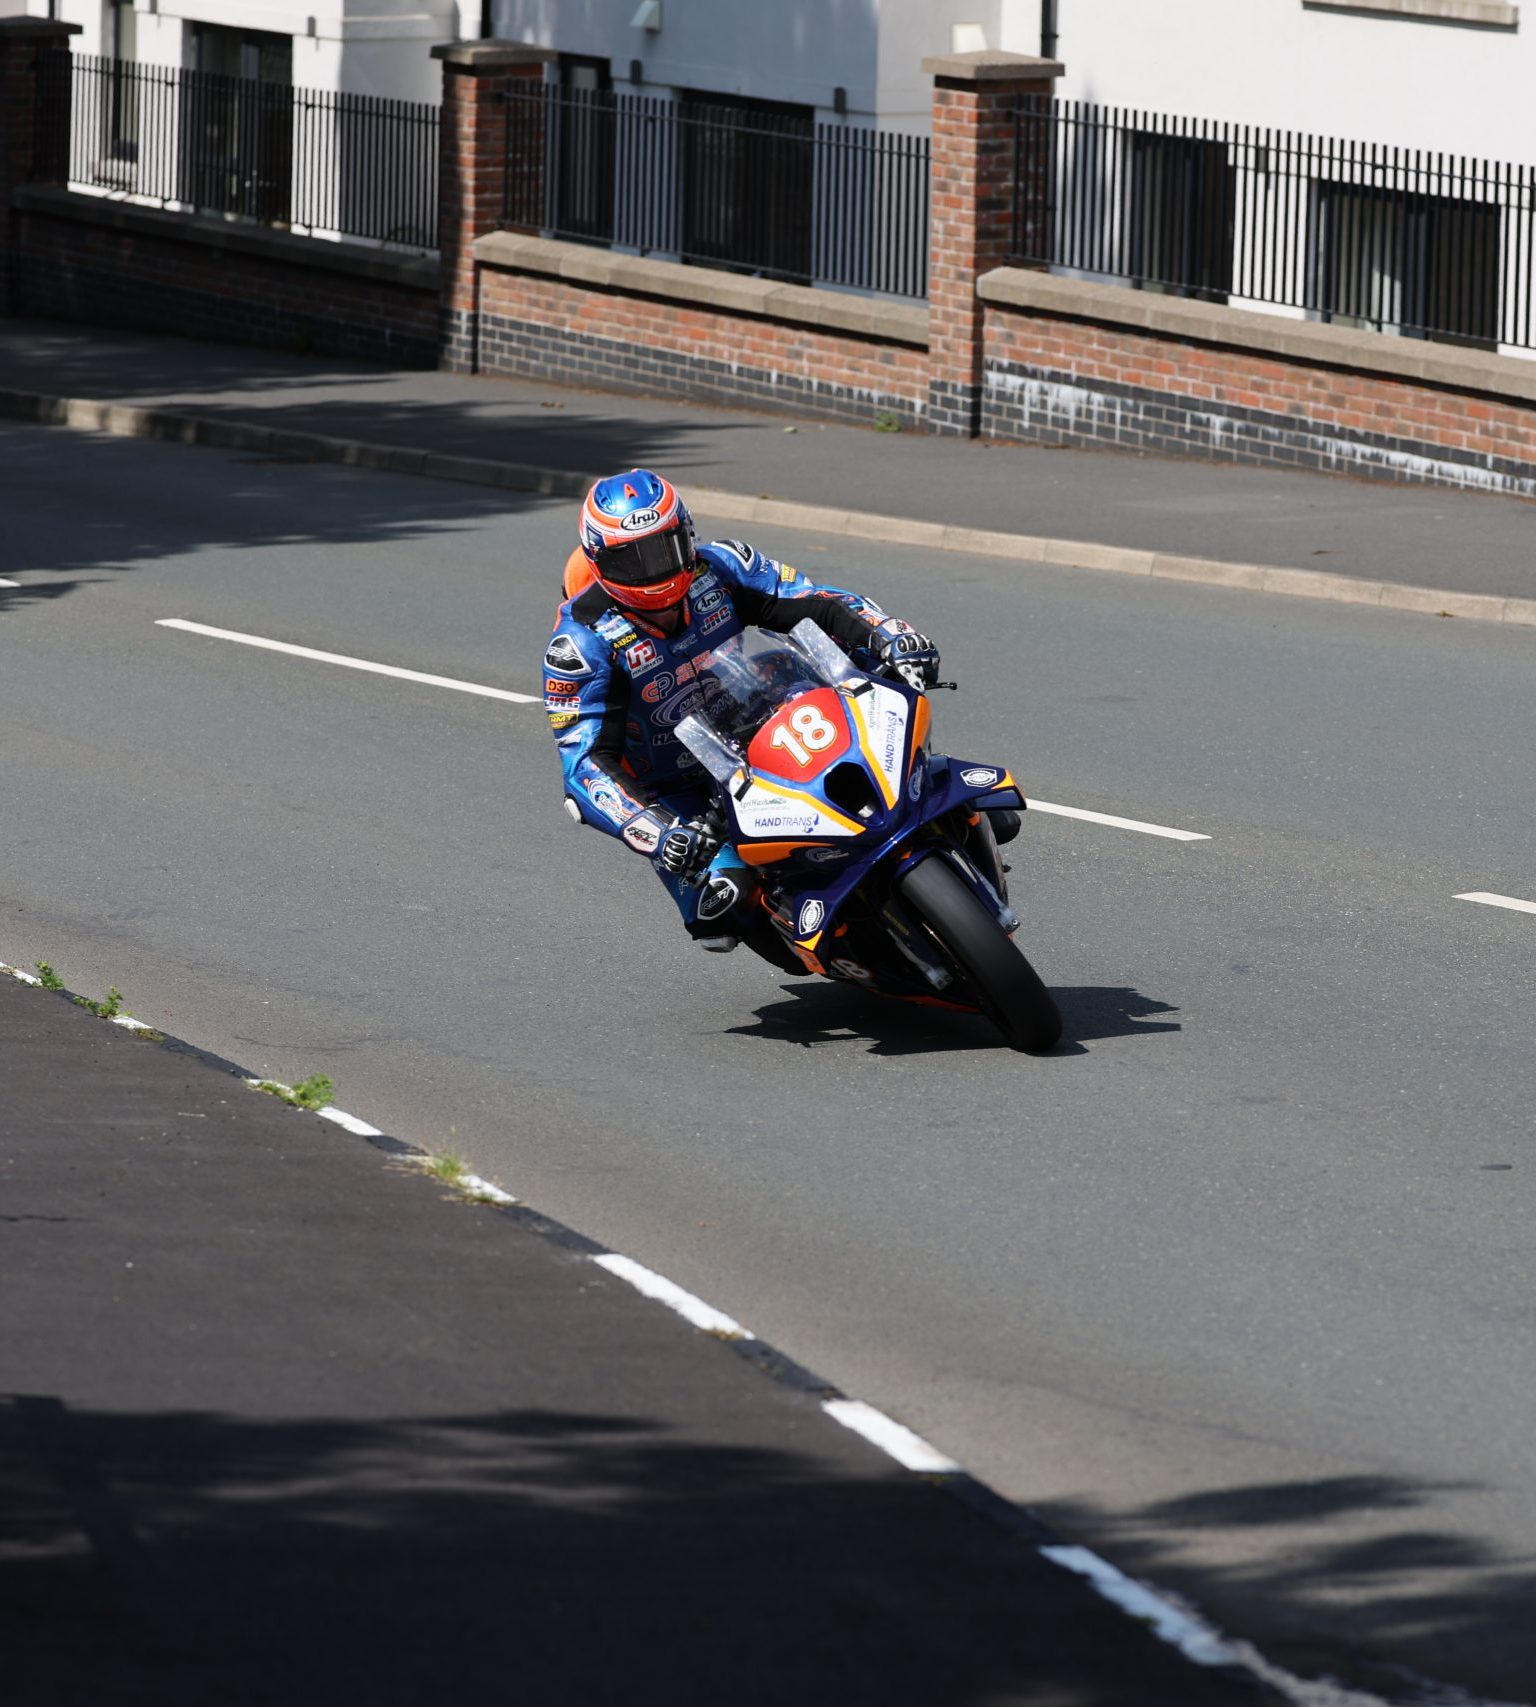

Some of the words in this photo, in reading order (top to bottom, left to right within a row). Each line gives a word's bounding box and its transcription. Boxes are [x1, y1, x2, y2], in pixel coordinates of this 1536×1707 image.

[628, 510, 656, 527] Arai
[701, 591, 722, 609] Arai
[770, 704, 836, 767] 18
[884, 715, 898, 773] HANDTRANS
[754, 815, 813, 828] HANDTRANS
